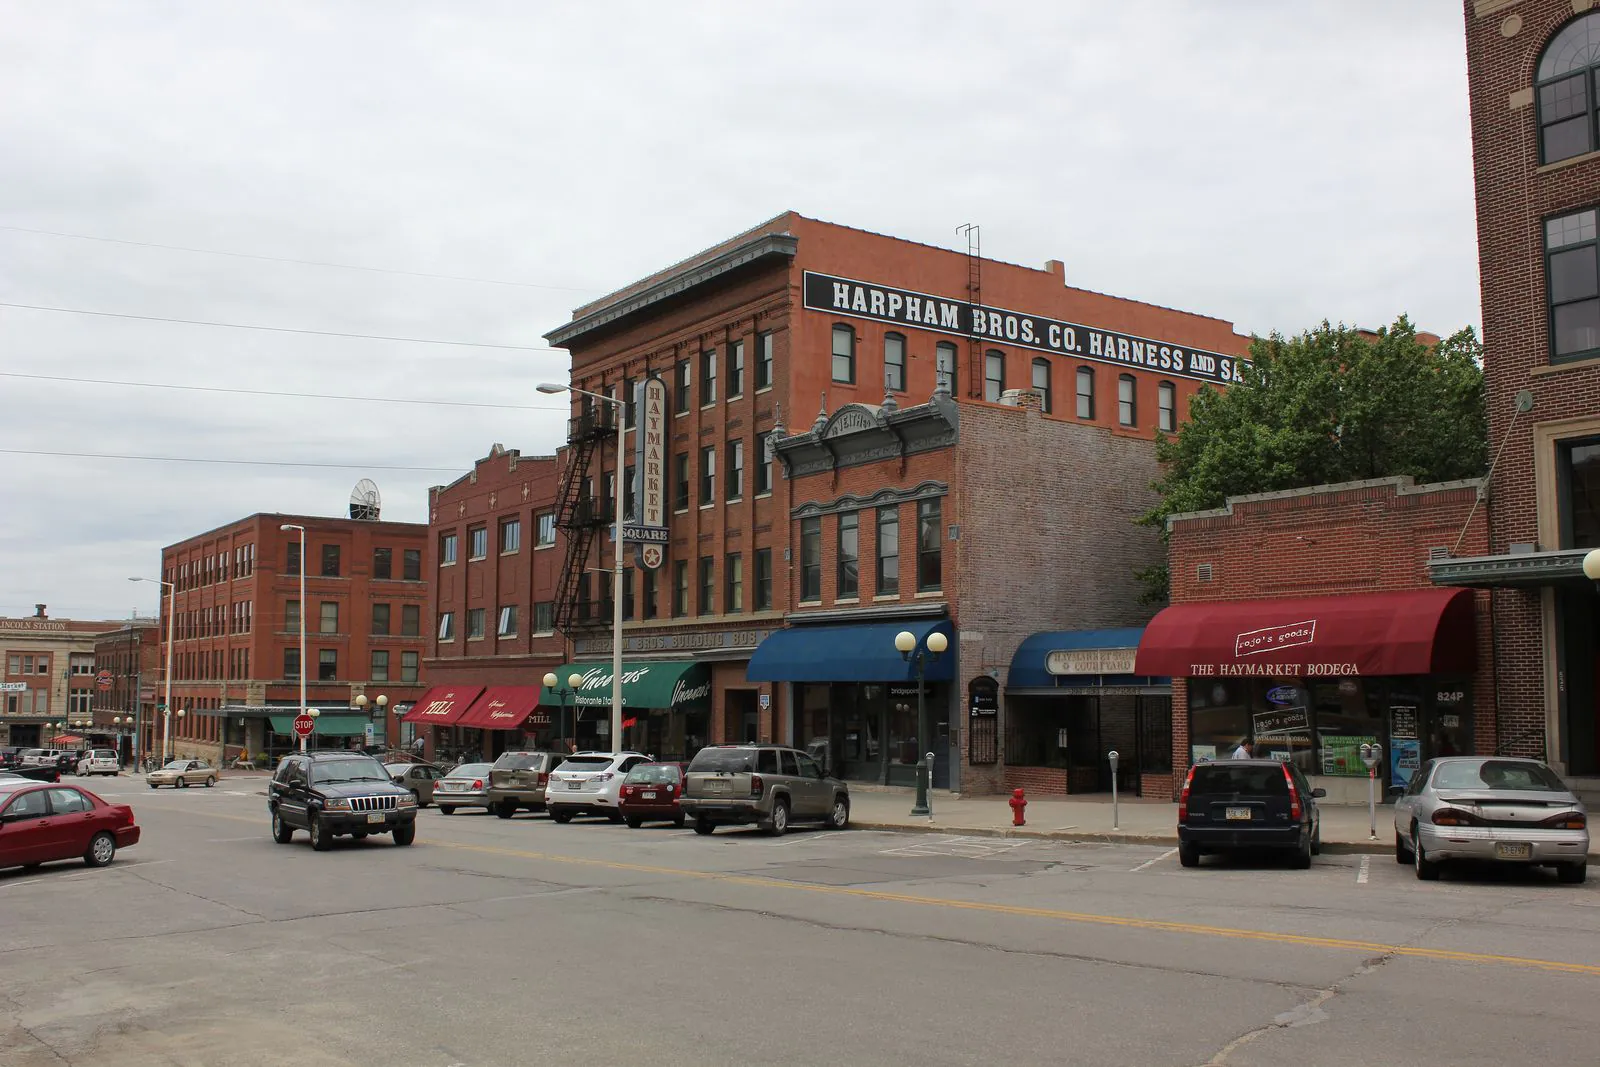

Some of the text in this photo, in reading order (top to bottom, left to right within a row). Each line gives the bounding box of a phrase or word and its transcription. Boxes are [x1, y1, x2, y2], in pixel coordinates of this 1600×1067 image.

[833, 282, 959, 329] HARPHAM
[972, 309, 1040, 344] BROS.
[1049, 324, 1081, 352] CO.
[1089, 332, 1184, 371] HARNESS
[1190, 354, 1215, 376] AND
[837, 412, 863, 431] VEITH
[647, 387, 661, 522] HAYMARKET
[623, 529, 668, 541] SQUARE
[0, 621, 66, 630] INCOLN STATION
[637, 637, 667, 650] BROS.
[671, 633, 724, 648] BUILDING
[1238, 629, 1313, 649] rojo's goods.
[1075, 661, 1131, 672] COURTYARD
[1191, 664, 1360, 676] THE HAYMARKET BODEGA
[580, 667, 650, 690] Vincezo's
[575, 696, 602, 705] Ristorante
[1437, 692, 1464, 701] 824P
[422, 701, 455, 714] MILL
[295, 721, 313, 729] STOP
